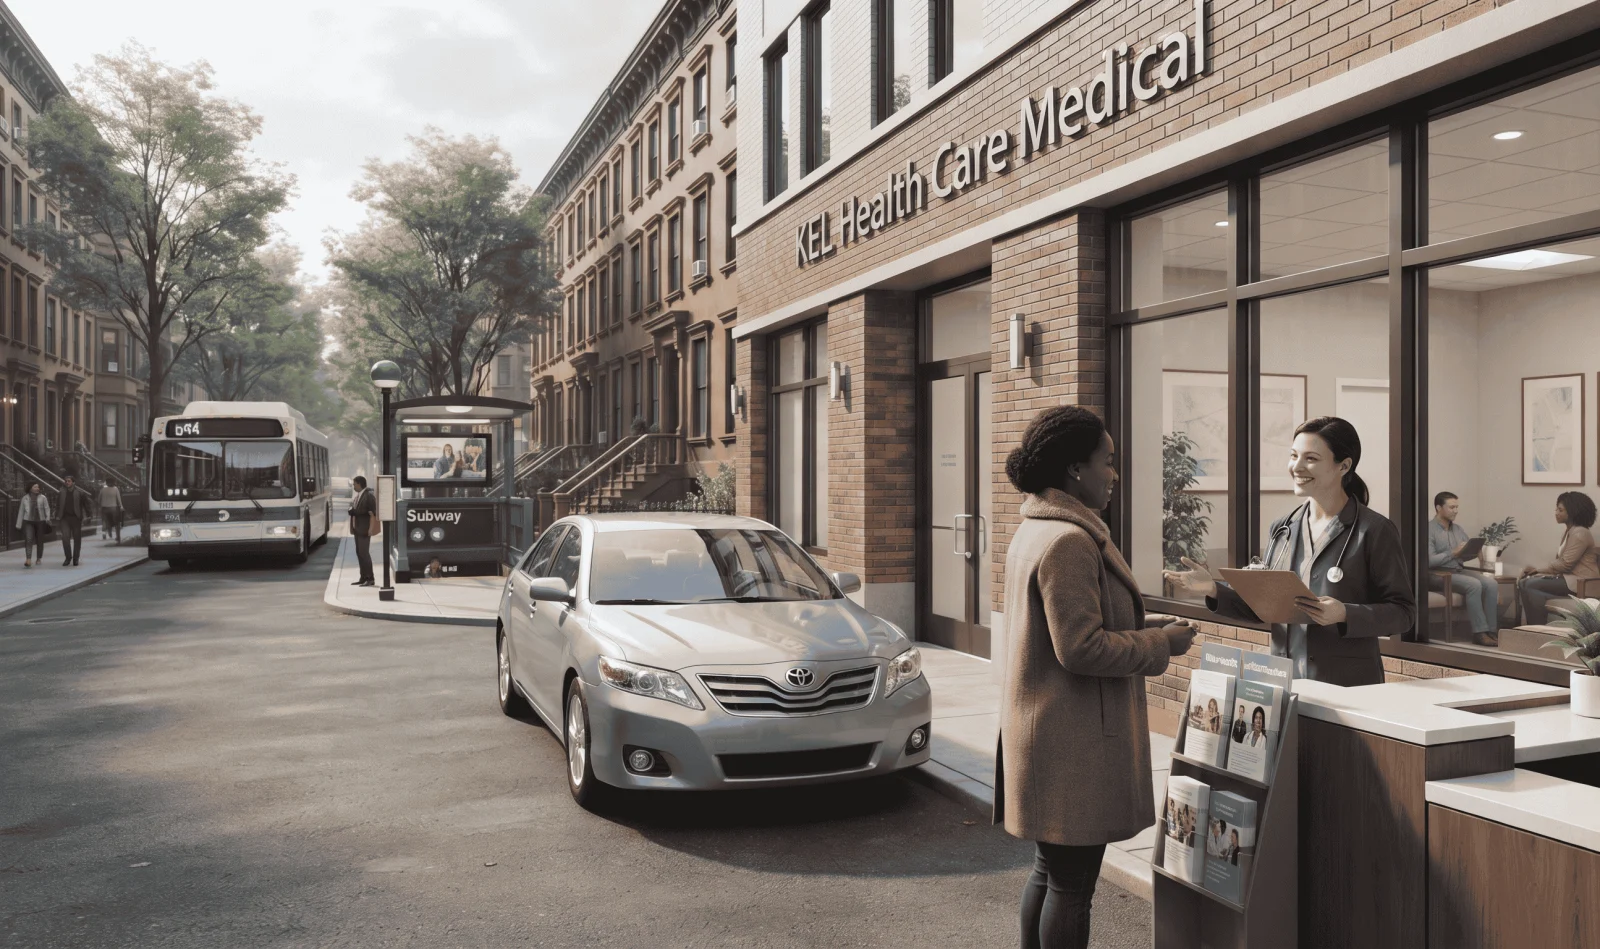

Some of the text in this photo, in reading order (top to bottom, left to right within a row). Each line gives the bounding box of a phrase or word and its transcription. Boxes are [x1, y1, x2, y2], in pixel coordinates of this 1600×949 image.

[795, 0, 1205, 267] KEL Health Care Medical
[406, 509, 462, 525] Subway
